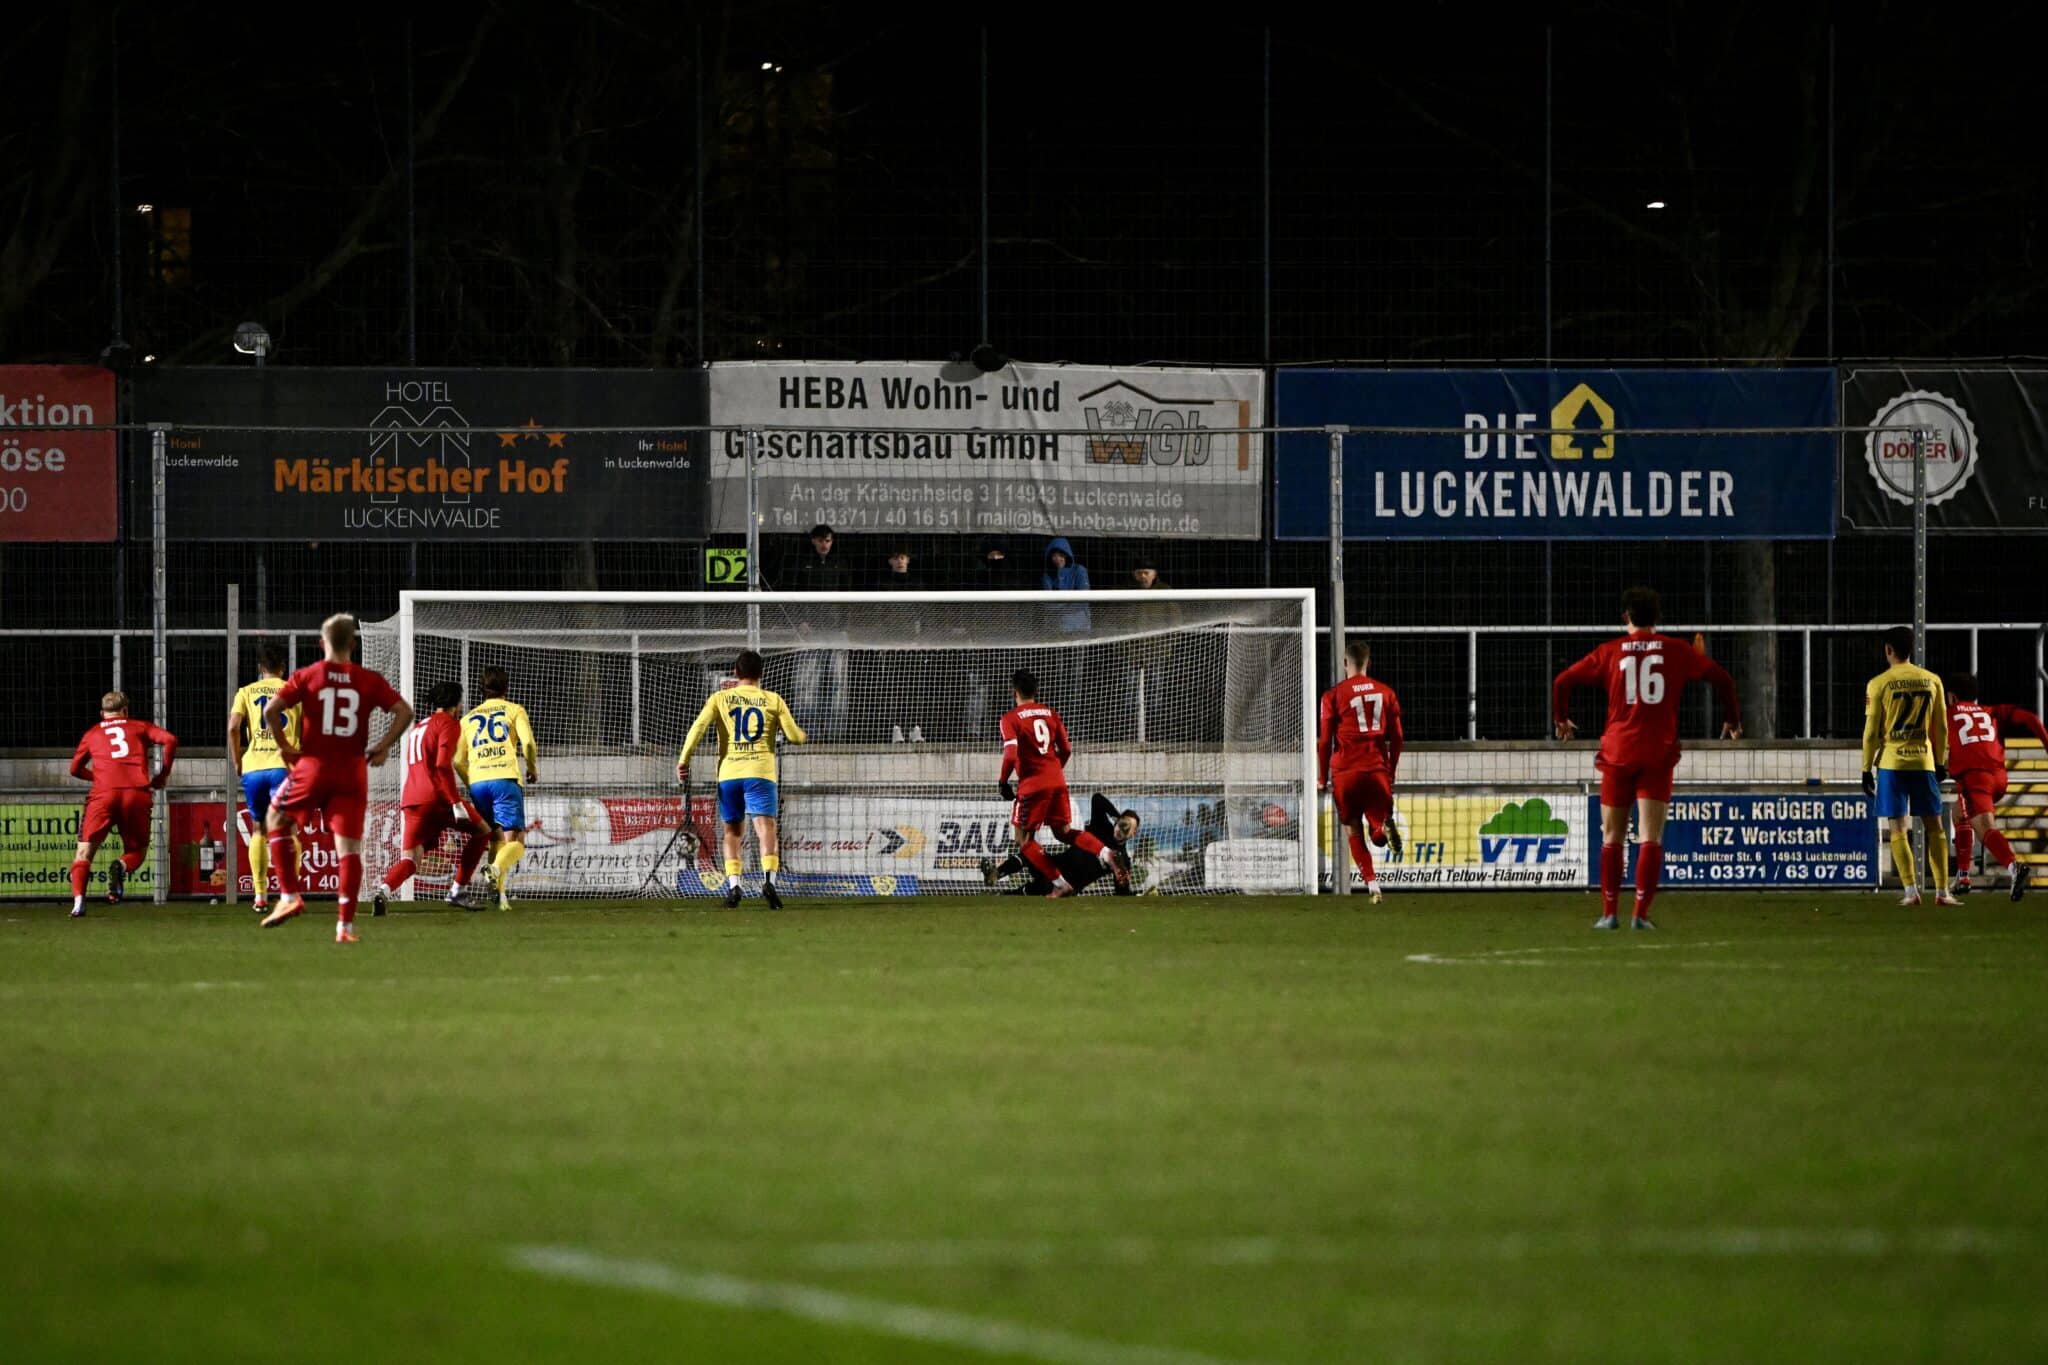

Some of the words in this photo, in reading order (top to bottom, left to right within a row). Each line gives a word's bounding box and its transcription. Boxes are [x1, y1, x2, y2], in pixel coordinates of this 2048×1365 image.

[386, 382, 451, 402] HOTEL
[780, 376, 868, 409] HEBA
[881, 377, 988, 409] Wohn-
[1003, 380, 1059, 412] und
[638, 439, 653, 451] Ihr
[657, 439, 688, 451] Hotel
[967, 431, 1059, 461] GmbH
[1464, 413, 1537, 459] DIE
[165, 455, 239, 469] Luckenwalde
[274, 457, 492, 494] Märkischer
[499, 458, 571, 494] Hof
[604, 458, 615, 469] in
[618, 457, 691, 469] Luckenwalde
[790, 483, 815, 502] An
[821, 483, 849, 502] der
[979, 484, 989, 502] 3
[1063, 486, 1184, 508] Luckenwalde
[1374, 470, 1735, 518] LUCKENWALDER
[345, 508, 501, 528] LUCKENWALDE
[815, 507, 867, 526] 03371
[885, 508, 906, 527] 40
[913, 508, 934, 528] 16
[939, 508, 959, 528] 51
[709, 556, 748, 581] D2
[1619, 654, 1665, 705] 16
[317, 686, 361, 737] 13
[728, 706, 764, 742] 10
[1350, 692, 1384, 733] 17
[1892, 690, 1932, 731] 27
[105, 726, 129, 759] 3
[469, 711, 510, 748] 26
[1033, 718, 1051, 755] 9
[1953, 712, 1995, 746] 23
[408, 724, 429, 765] 11
[1665, 802, 1723, 820] ERNST
[1728, 805, 1745, 820] u.
[1751, 797, 1825, 820] KRÜGER
[1831, 801, 1868, 820] GbR
[27, 809, 81, 836] und
[1701, 826, 1734, 845] KFZ
[1742, 826, 1831, 845] Werkstatt
[1415, 842, 1444, 864] TF!
[1480, 837, 1567, 864] VTF
[1736, 851, 1753, 863] Str.
[1771, 851, 1802, 863] 14943
[1805, 851, 1868, 863] Luckenwalde
[1446, 868, 1543, 884] Teltow-Fläming
[1546, 868, 1577, 882] mbH
[1665, 864, 1705, 880] Tel.:
[1710, 864, 1767, 880] 03371
[1785, 864, 1809, 880] 63
[1815, 864, 1841, 880] 07
[1843, 864, 1868, 880] 86
